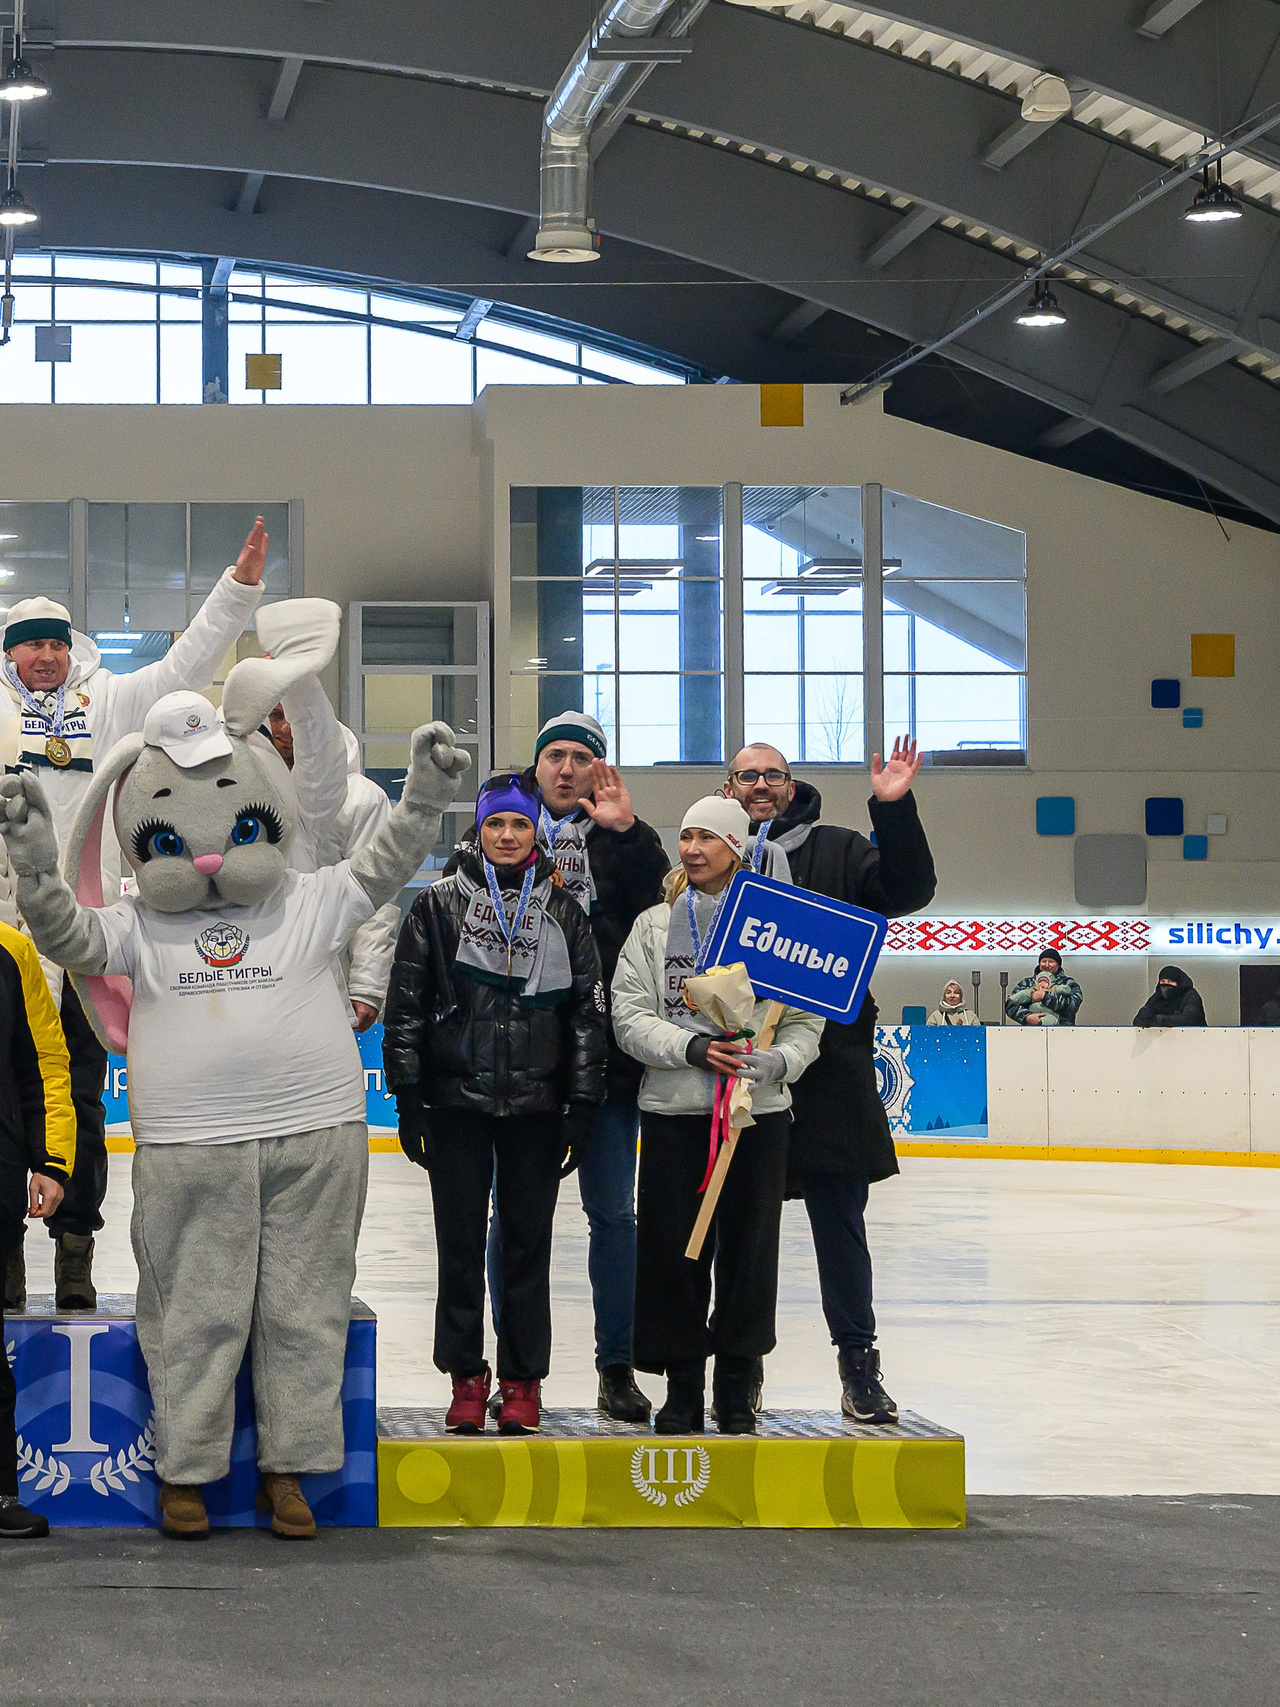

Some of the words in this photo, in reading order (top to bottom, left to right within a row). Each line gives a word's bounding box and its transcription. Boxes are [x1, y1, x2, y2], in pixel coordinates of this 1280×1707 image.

[738, 916, 850, 978] Единые
[178, 969, 224, 984] БЕЛЫЕ
[226, 965, 273, 980] ТИГРЫ
[644, 1448, 698, 1484] III
